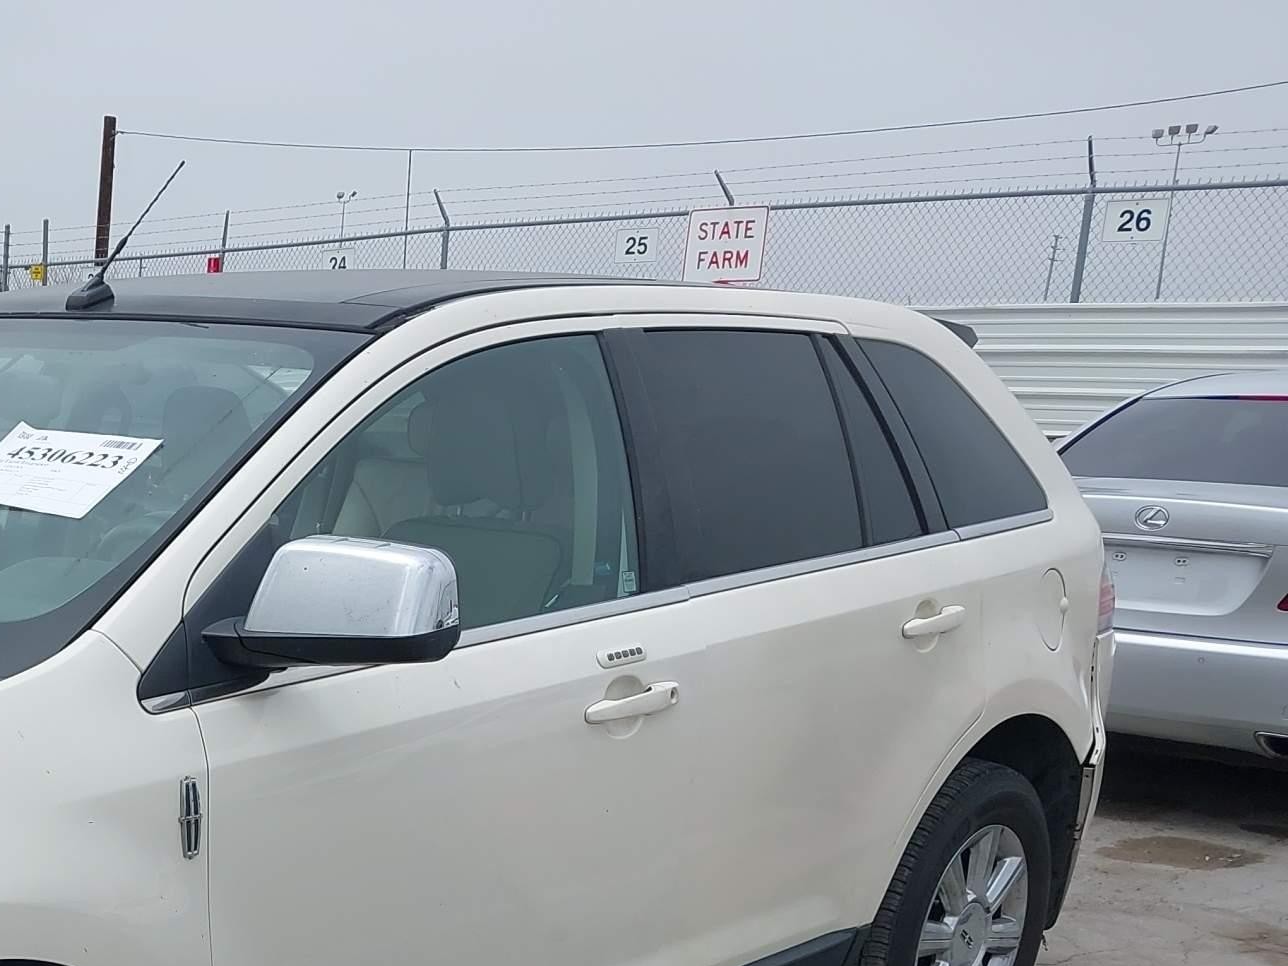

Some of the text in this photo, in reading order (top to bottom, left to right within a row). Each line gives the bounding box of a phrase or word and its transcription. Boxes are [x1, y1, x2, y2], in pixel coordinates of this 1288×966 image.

[697, 219, 756, 241] STATE
[1116, 208, 1152, 232] 26
[624, 236, 649, 256] 25
[329, 255, 347, 270] 24
[696, 250, 750, 270] FARM
[7, 445, 124, 469] 45306223
